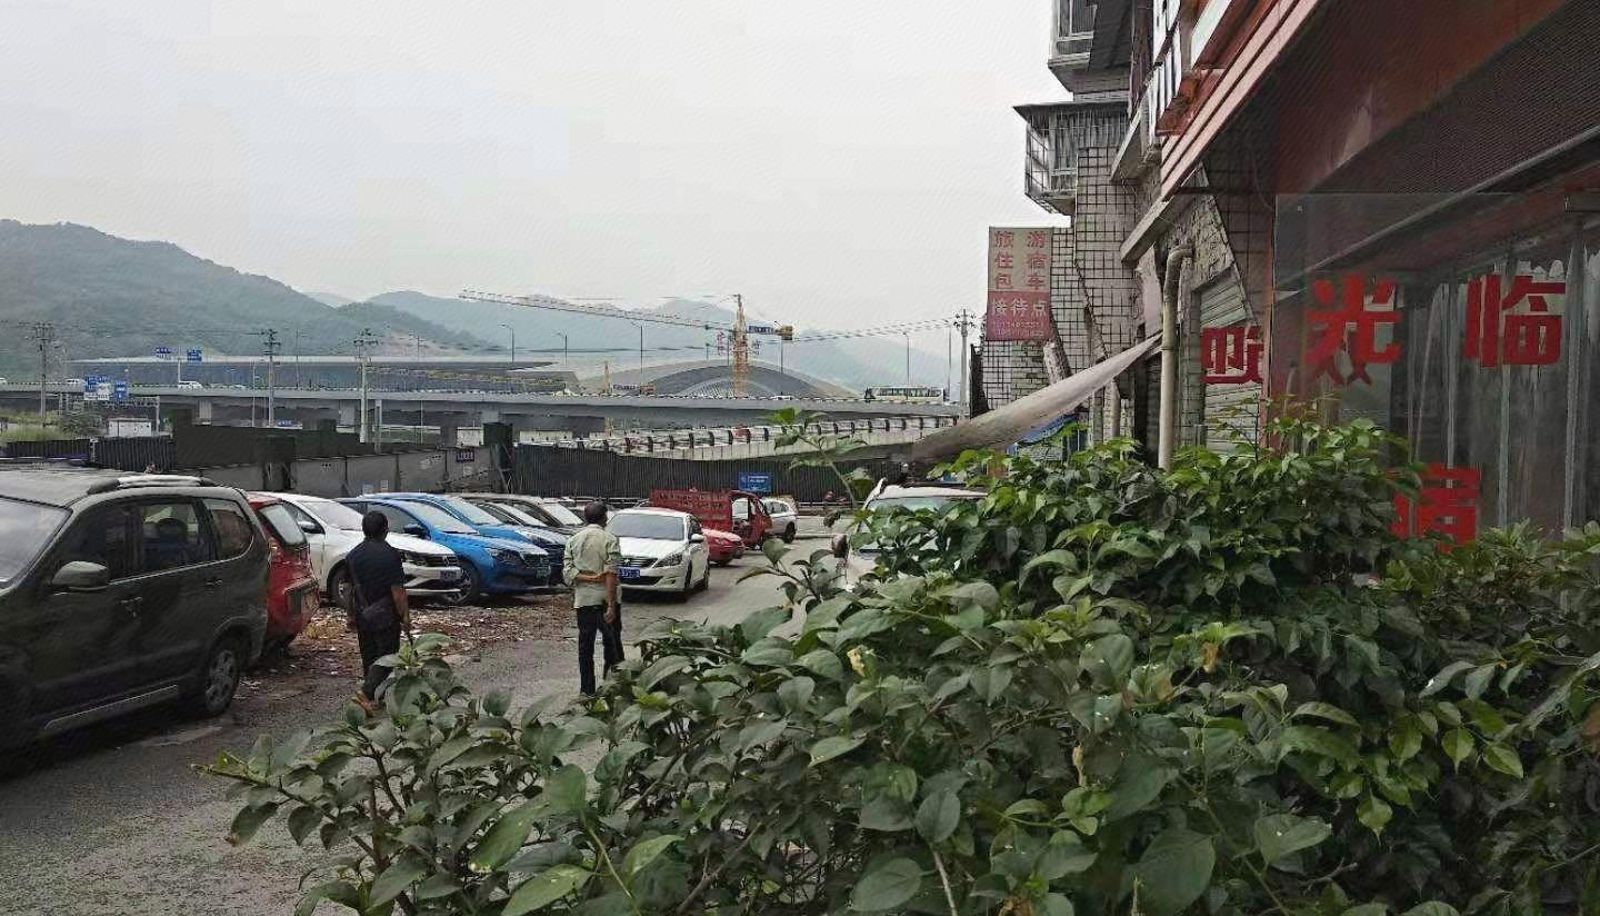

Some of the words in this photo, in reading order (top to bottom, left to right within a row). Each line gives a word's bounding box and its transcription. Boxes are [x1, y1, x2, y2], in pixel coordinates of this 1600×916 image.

[993, 230, 1047, 248] 旅游
[994, 251, 1047, 272] 住宿
[994, 273, 1046, 290] 包车
[991, 297, 1048, 318] 接待点
